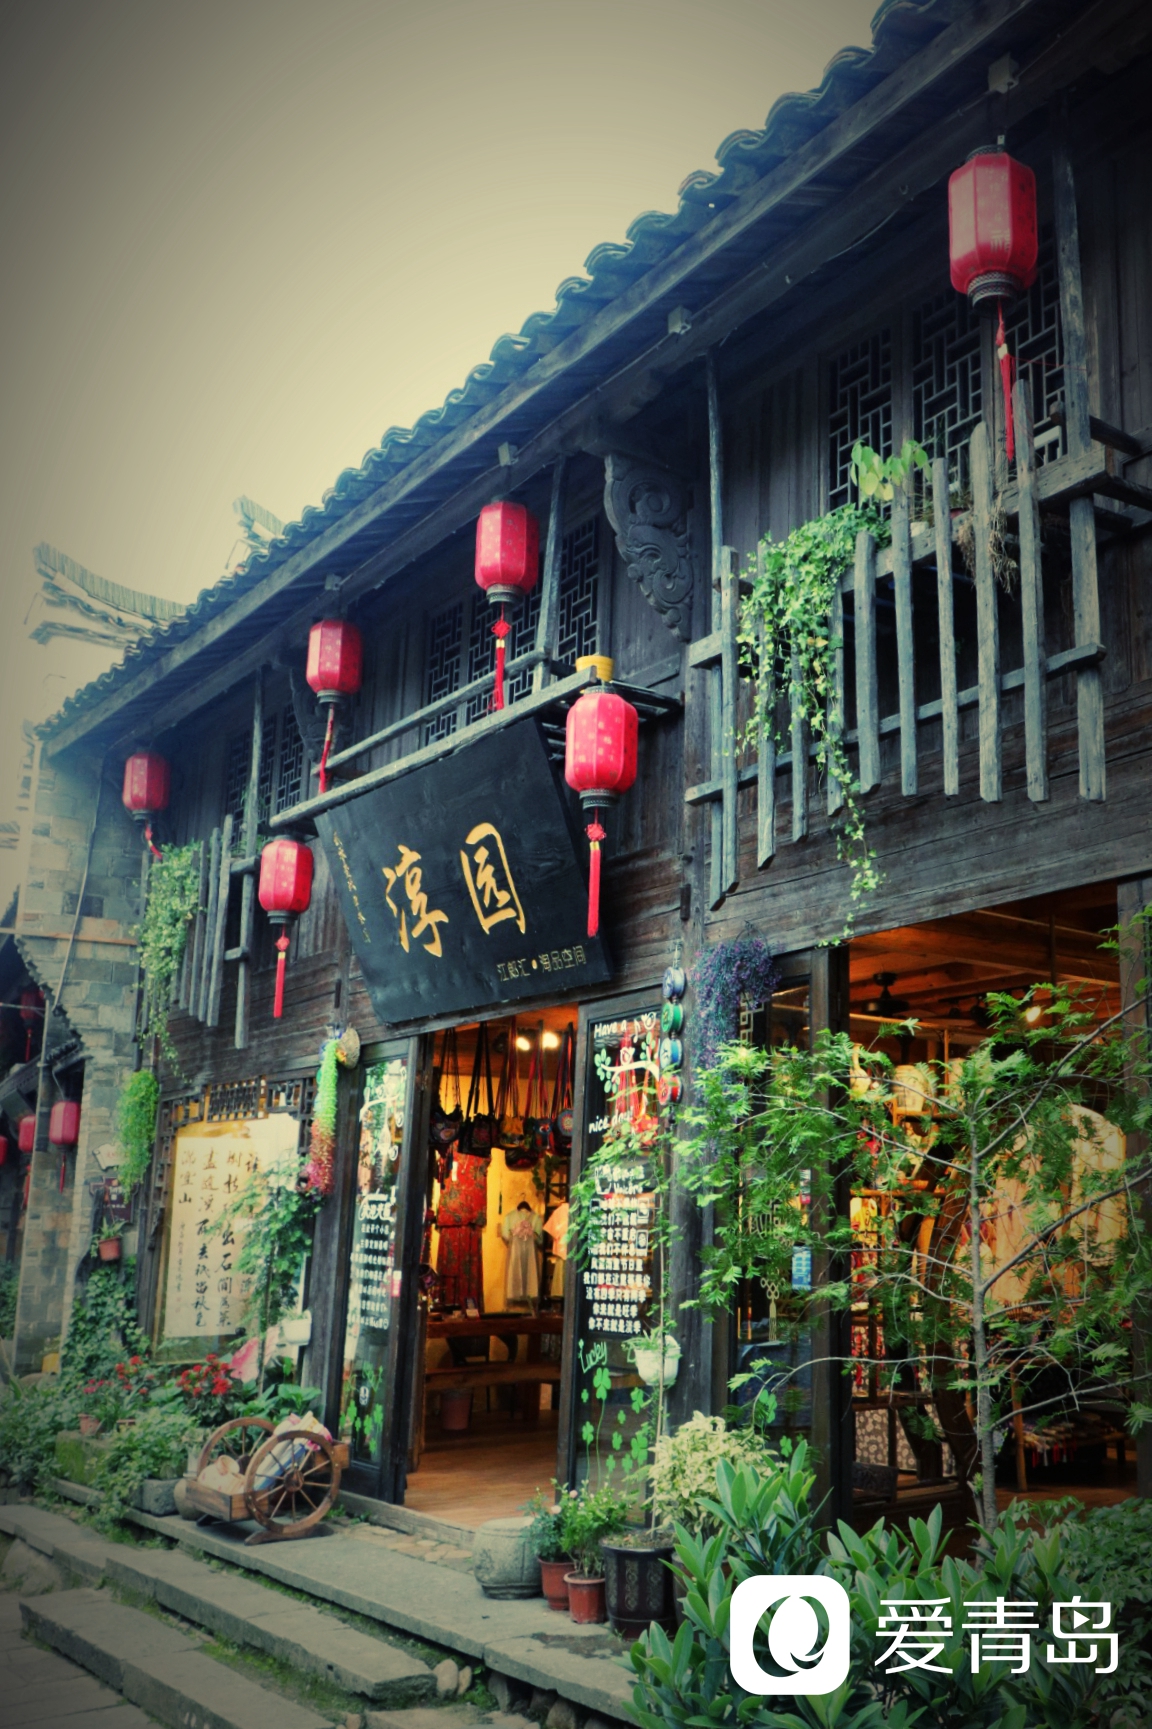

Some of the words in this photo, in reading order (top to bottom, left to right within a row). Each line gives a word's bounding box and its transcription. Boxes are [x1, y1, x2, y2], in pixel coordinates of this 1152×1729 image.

[594, 1022, 618, 1038] Have
[621, 1020, 627, 1032] a
[589, 1115, 609, 1133] nice
[593, 1302, 638, 1318] 你来就是旺季
[588, 1317, 641, 1334] 你不来就是淡季
